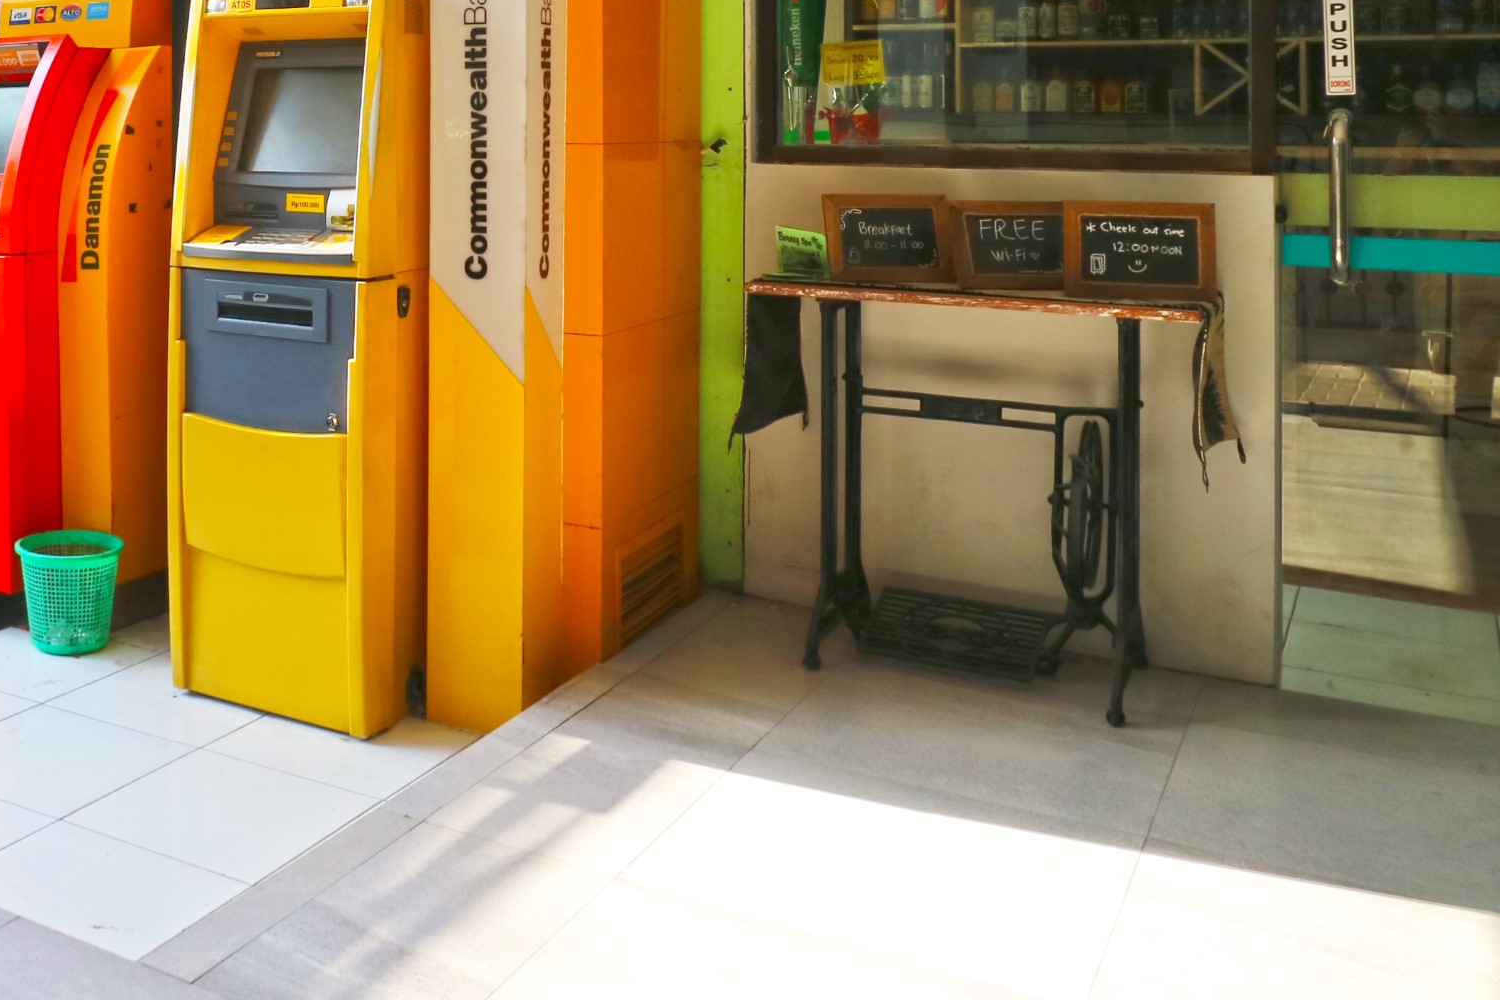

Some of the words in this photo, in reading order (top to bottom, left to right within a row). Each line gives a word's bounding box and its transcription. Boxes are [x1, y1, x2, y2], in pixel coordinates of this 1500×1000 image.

[13, 11, 28, 20] VISA
[62, 9, 81, 17] ALTO
[1330, 3, 1348, 67] PUSH
[1331, 80, 1351, 88] DORONG
[81, 144, 111, 270] Danamon
[979, 218, 1045, 241] FREE
